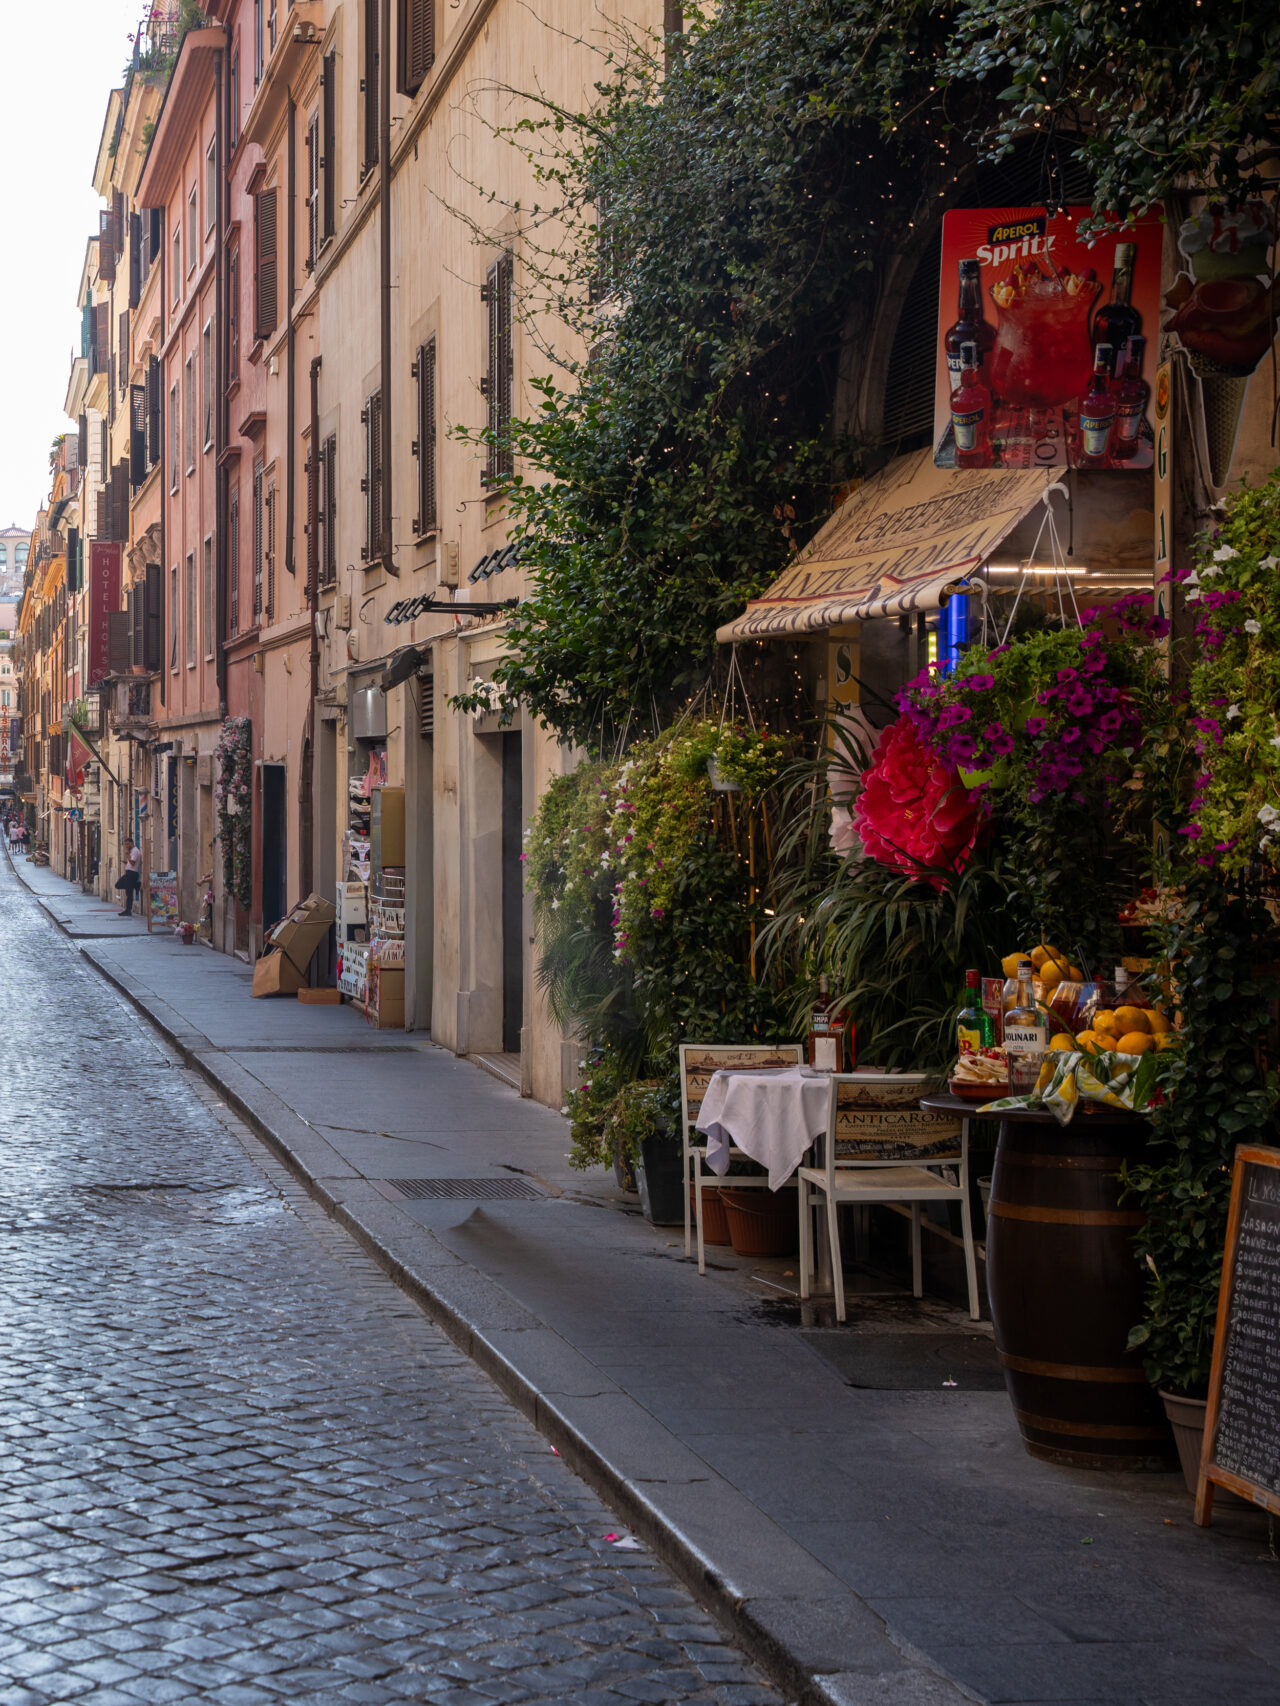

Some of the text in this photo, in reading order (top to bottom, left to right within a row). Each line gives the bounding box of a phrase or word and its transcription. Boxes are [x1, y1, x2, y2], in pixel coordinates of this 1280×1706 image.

[992, 222, 1040, 242] APEROL
[976, 234, 1056, 267] Spritz
[1, 704, 9, 773] RISTORANTE
